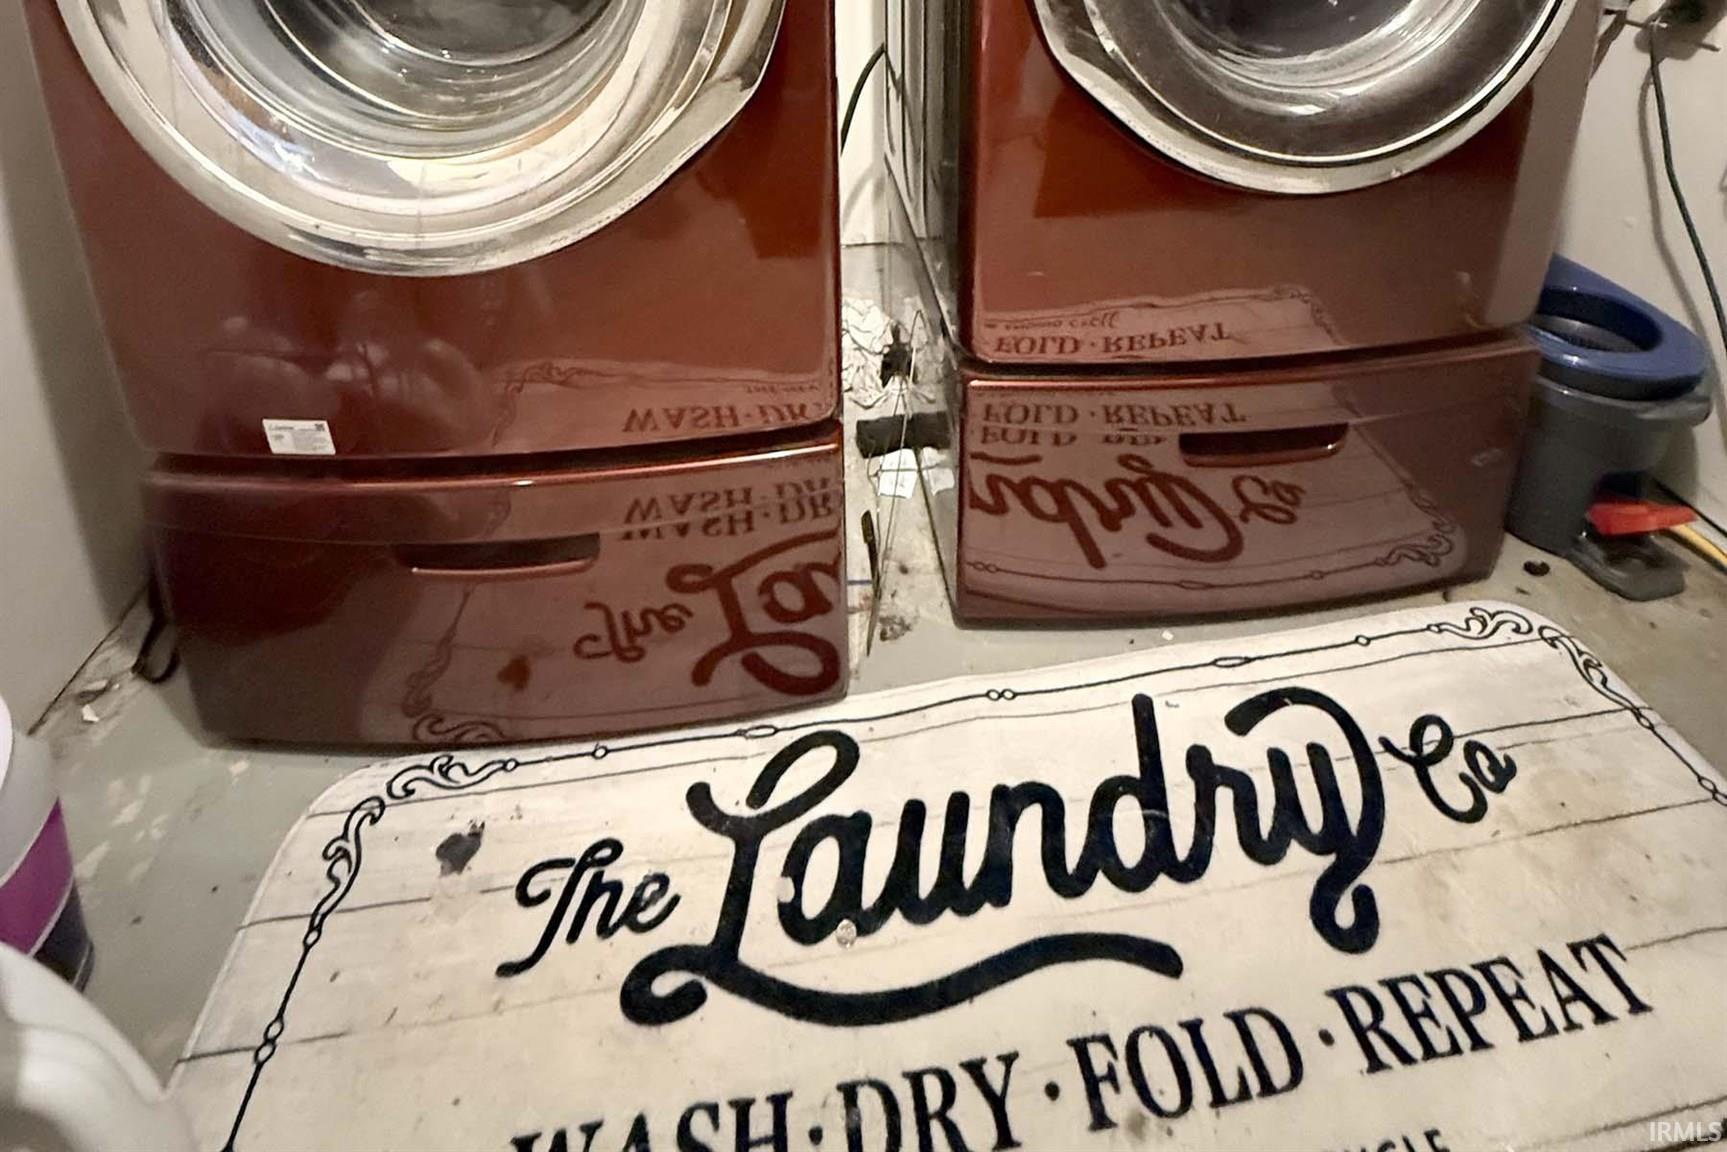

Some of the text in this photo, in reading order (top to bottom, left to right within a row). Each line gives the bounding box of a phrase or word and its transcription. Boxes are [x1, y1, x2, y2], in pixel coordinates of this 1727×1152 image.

[497, 686, 1518, 1028] The Laundry Co
[837, 1050, 1023, 1152] DRY
[1066, 1007, 1305, 1132] FOLD
[1325, 933, 1654, 1075] REPEAT
